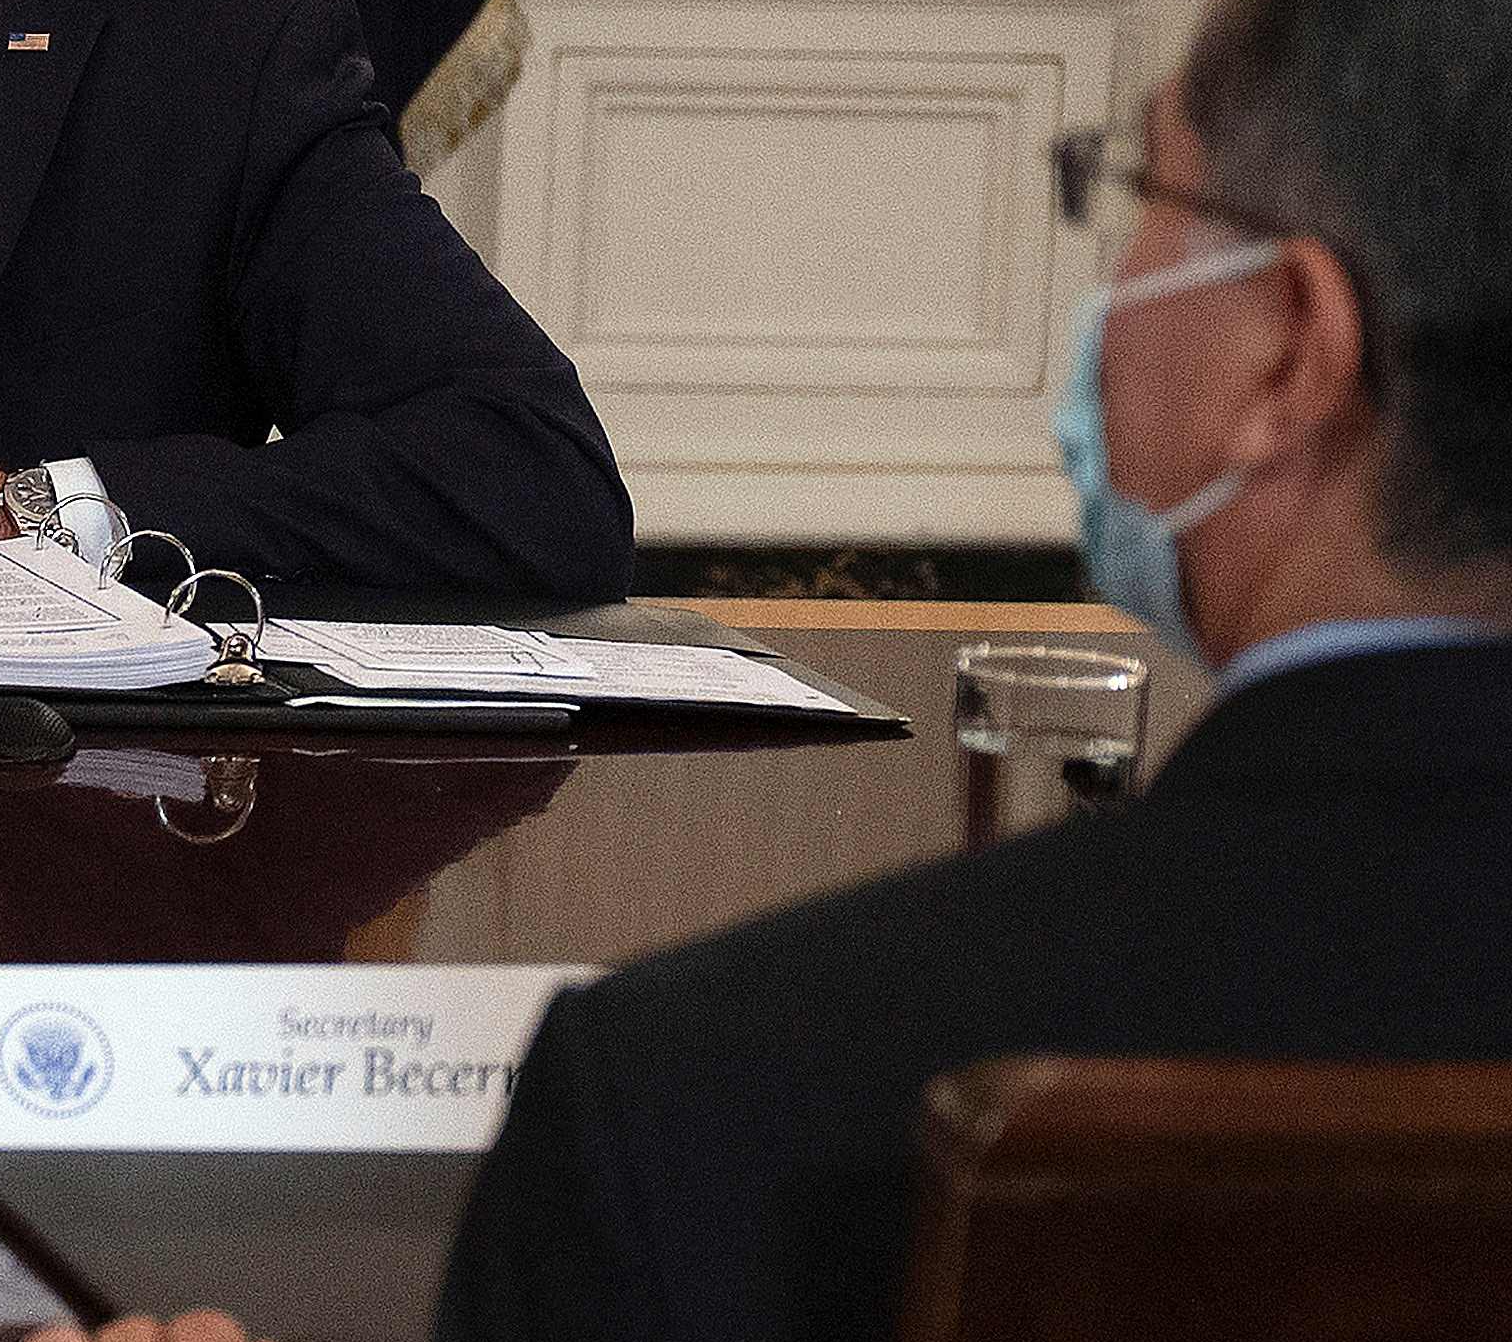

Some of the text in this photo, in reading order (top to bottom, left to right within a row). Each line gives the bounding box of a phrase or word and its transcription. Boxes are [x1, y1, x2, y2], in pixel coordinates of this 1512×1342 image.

[278, 1006, 434, 1046] Secretary
[176, 1046, 521, 1097] Xavier Becerr
